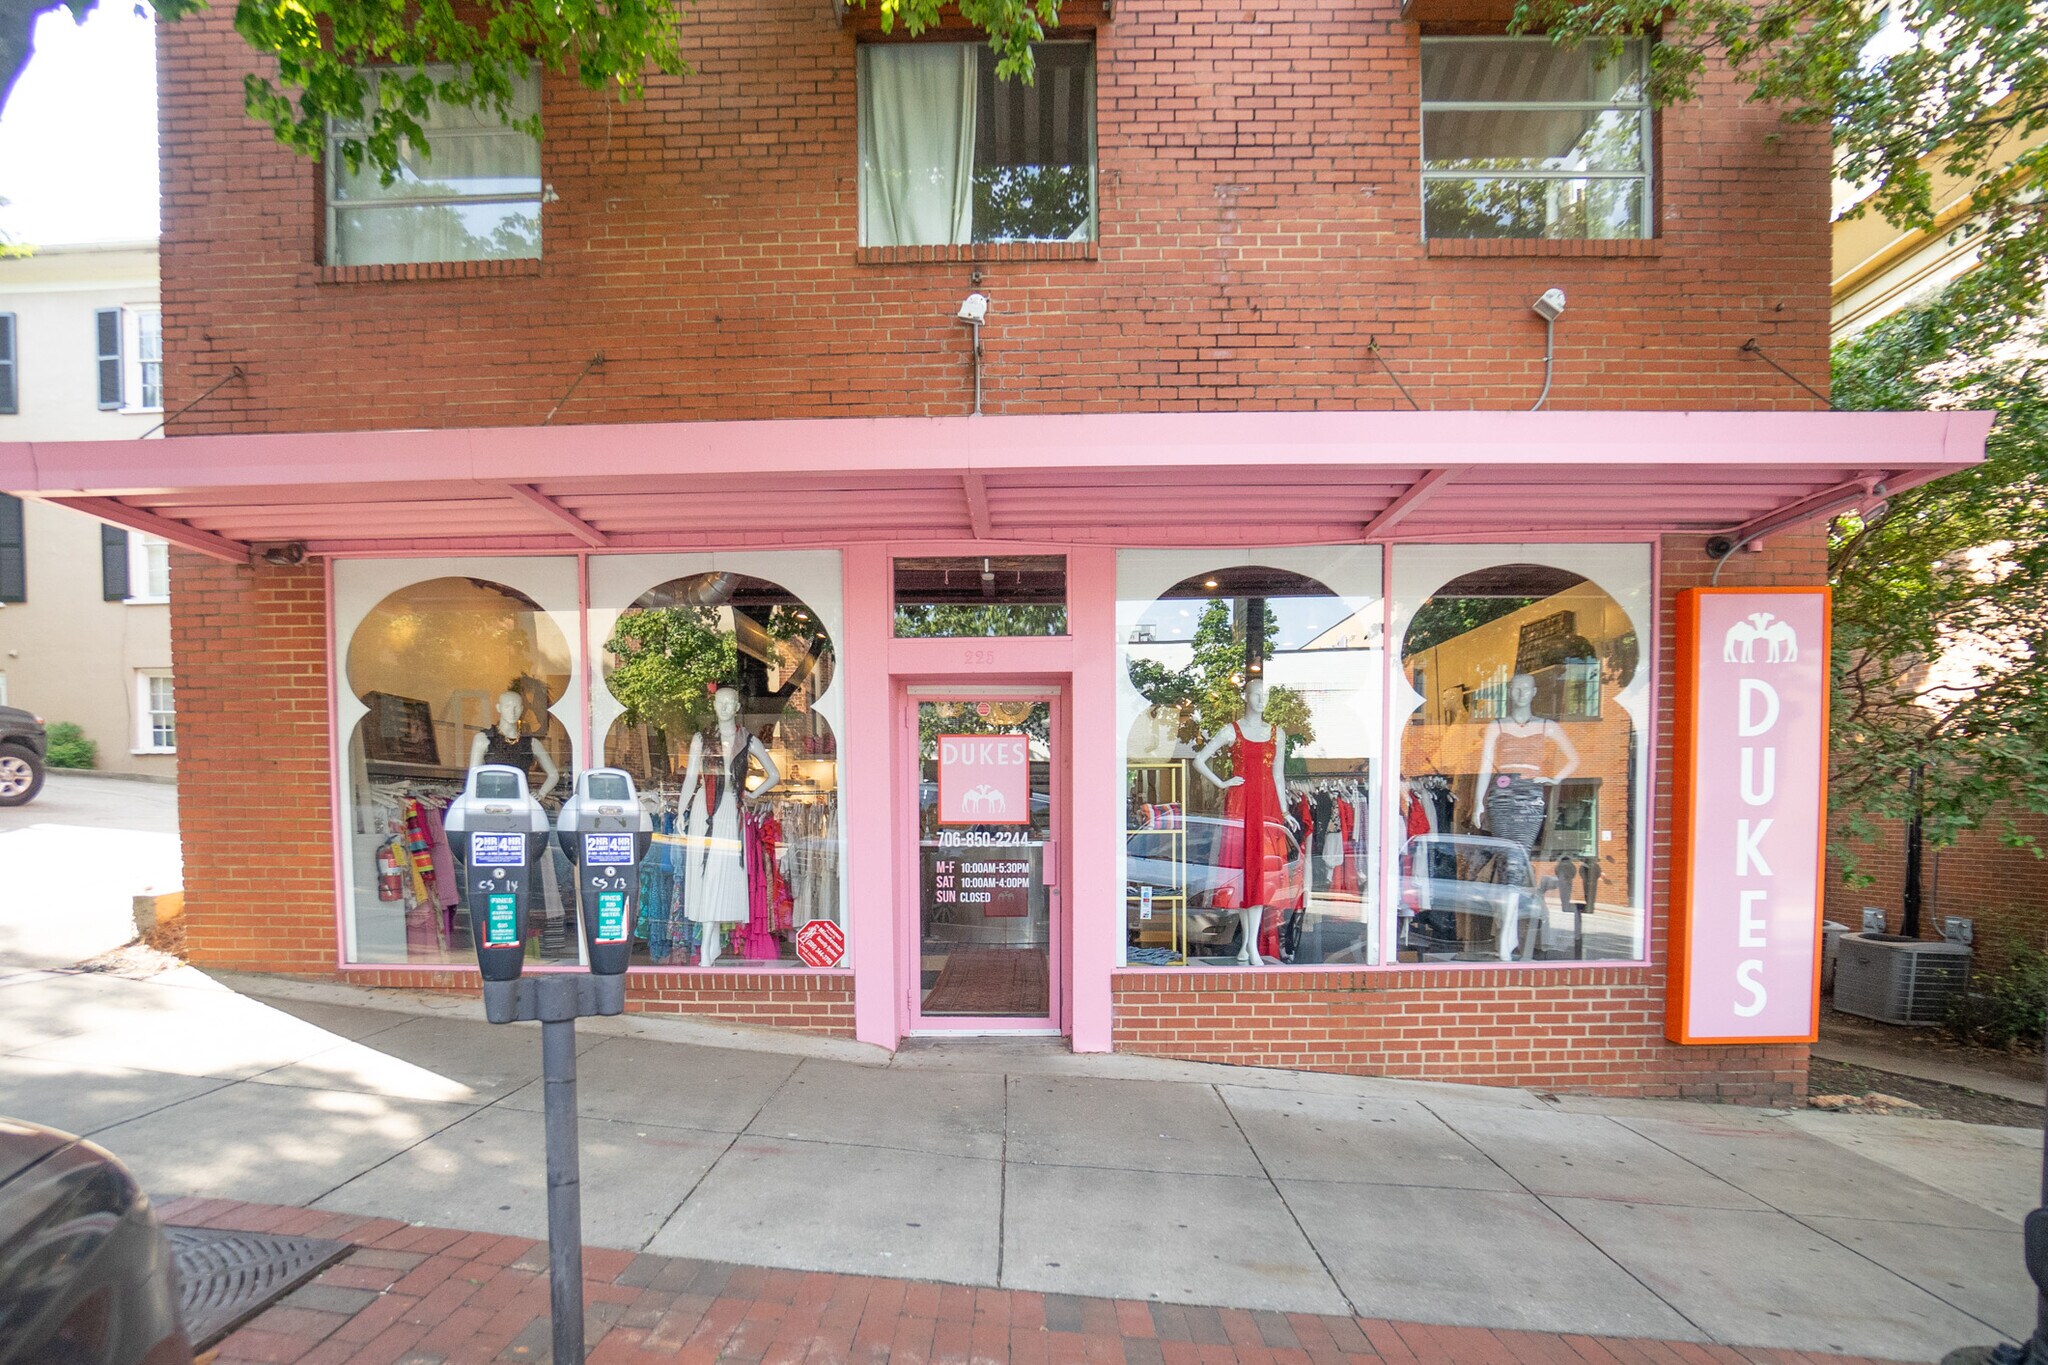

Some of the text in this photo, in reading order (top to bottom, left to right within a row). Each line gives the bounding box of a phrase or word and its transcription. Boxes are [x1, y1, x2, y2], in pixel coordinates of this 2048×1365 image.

[964, 650, 994, 665] 225
[942, 743, 1025, 766] DUKES
[475, 837, 498, 851] 2 HR
[499, 837, 521, 851] 4 HR
[588, 837, 609, 851] 2 HR
[610, 837, 630, 851] 4 HR
[936, 831, 1029, 847] 706-850-2244
[1733, 678, 1780, 1018] DUKES
[936, 860, 1029, 873] M-F 10:00AM-5:30PM
[936, 875, 1029, 888] SAT 10:00AM-4:00PM
[936, 890, 991, 903] SUN CLOSED
